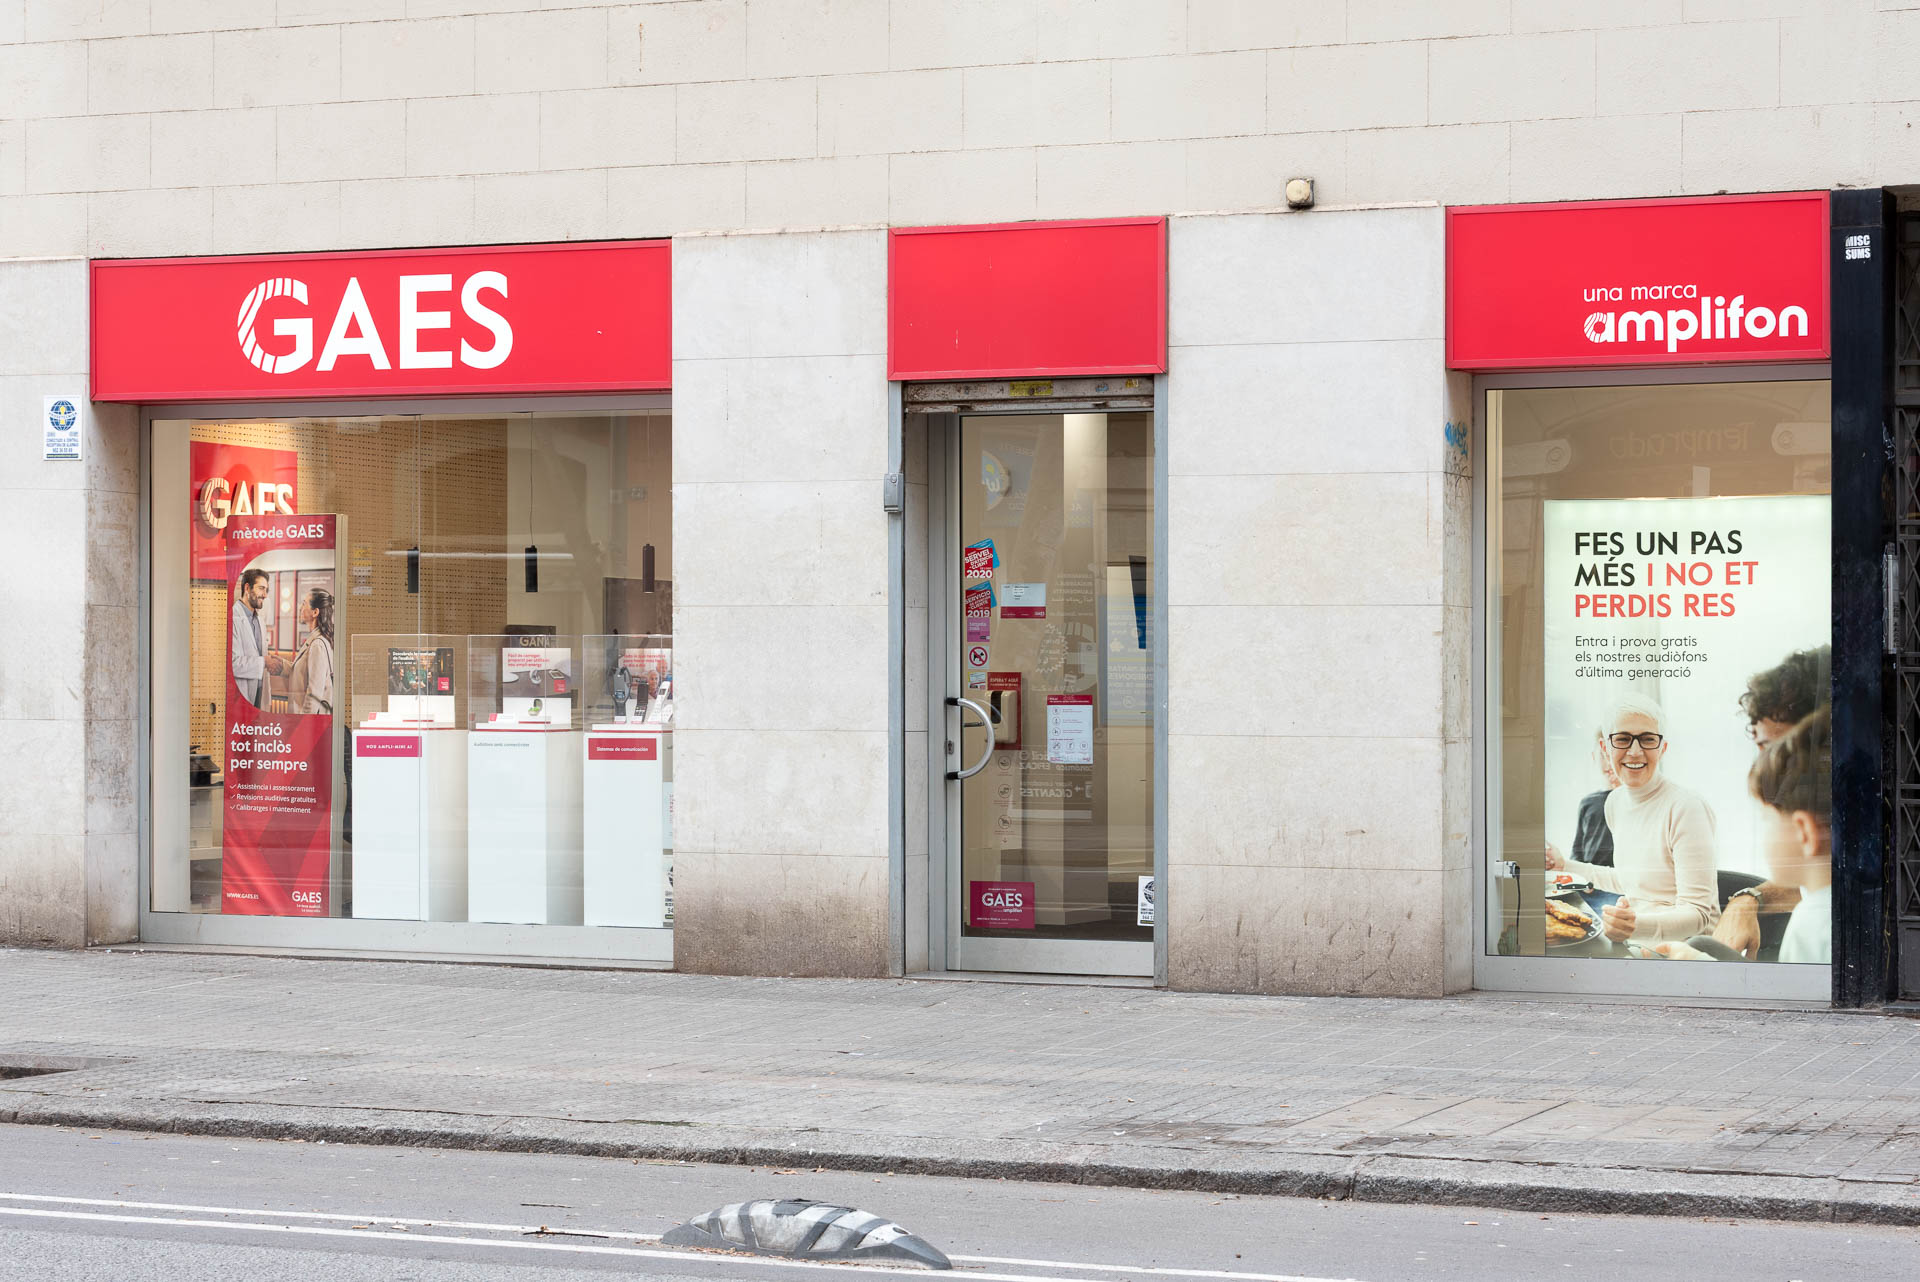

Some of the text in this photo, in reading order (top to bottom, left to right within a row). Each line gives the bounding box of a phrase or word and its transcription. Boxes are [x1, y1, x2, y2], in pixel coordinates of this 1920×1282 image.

[1845, 235, 1870, 246] MISC
[1845, 248, 1870, 260] SUMS
[1583, 284, 1697, 302] una marca
[237, 270, 513, 374] GAES
[1583, 294, 1808, 353] amplifon
[200, 477, 294, 529] GAES
[232, 524, 325, 539] mètode GAES
[1575, 530, 1743, 556] FES UN PAS
[964, 549, 990, 564] SERVEI
[966, 570, 993, 579] 2020
[1574, 557, 1759, 587] MÉS I NO ET
[1575, 592, 1736, 618] PERDIS RES
[967, 610, 990, 618] 2019
[1575, 635, 1698, 650] Entra i prova gratis
[1575, 650, 1708, 663] els nostres audiòfons
[1575, 666, 1691, 680] d'última generació
[231, 722, 282, 736] Atenció
[231, 739, 292, 753] tot inclòs
[230, 758, 308, 774] per sempre
[236, 804, 268, 812] Calibratges
[292, 891, 322, 903] GAES
[981, 892, 1023, 907] GAES
